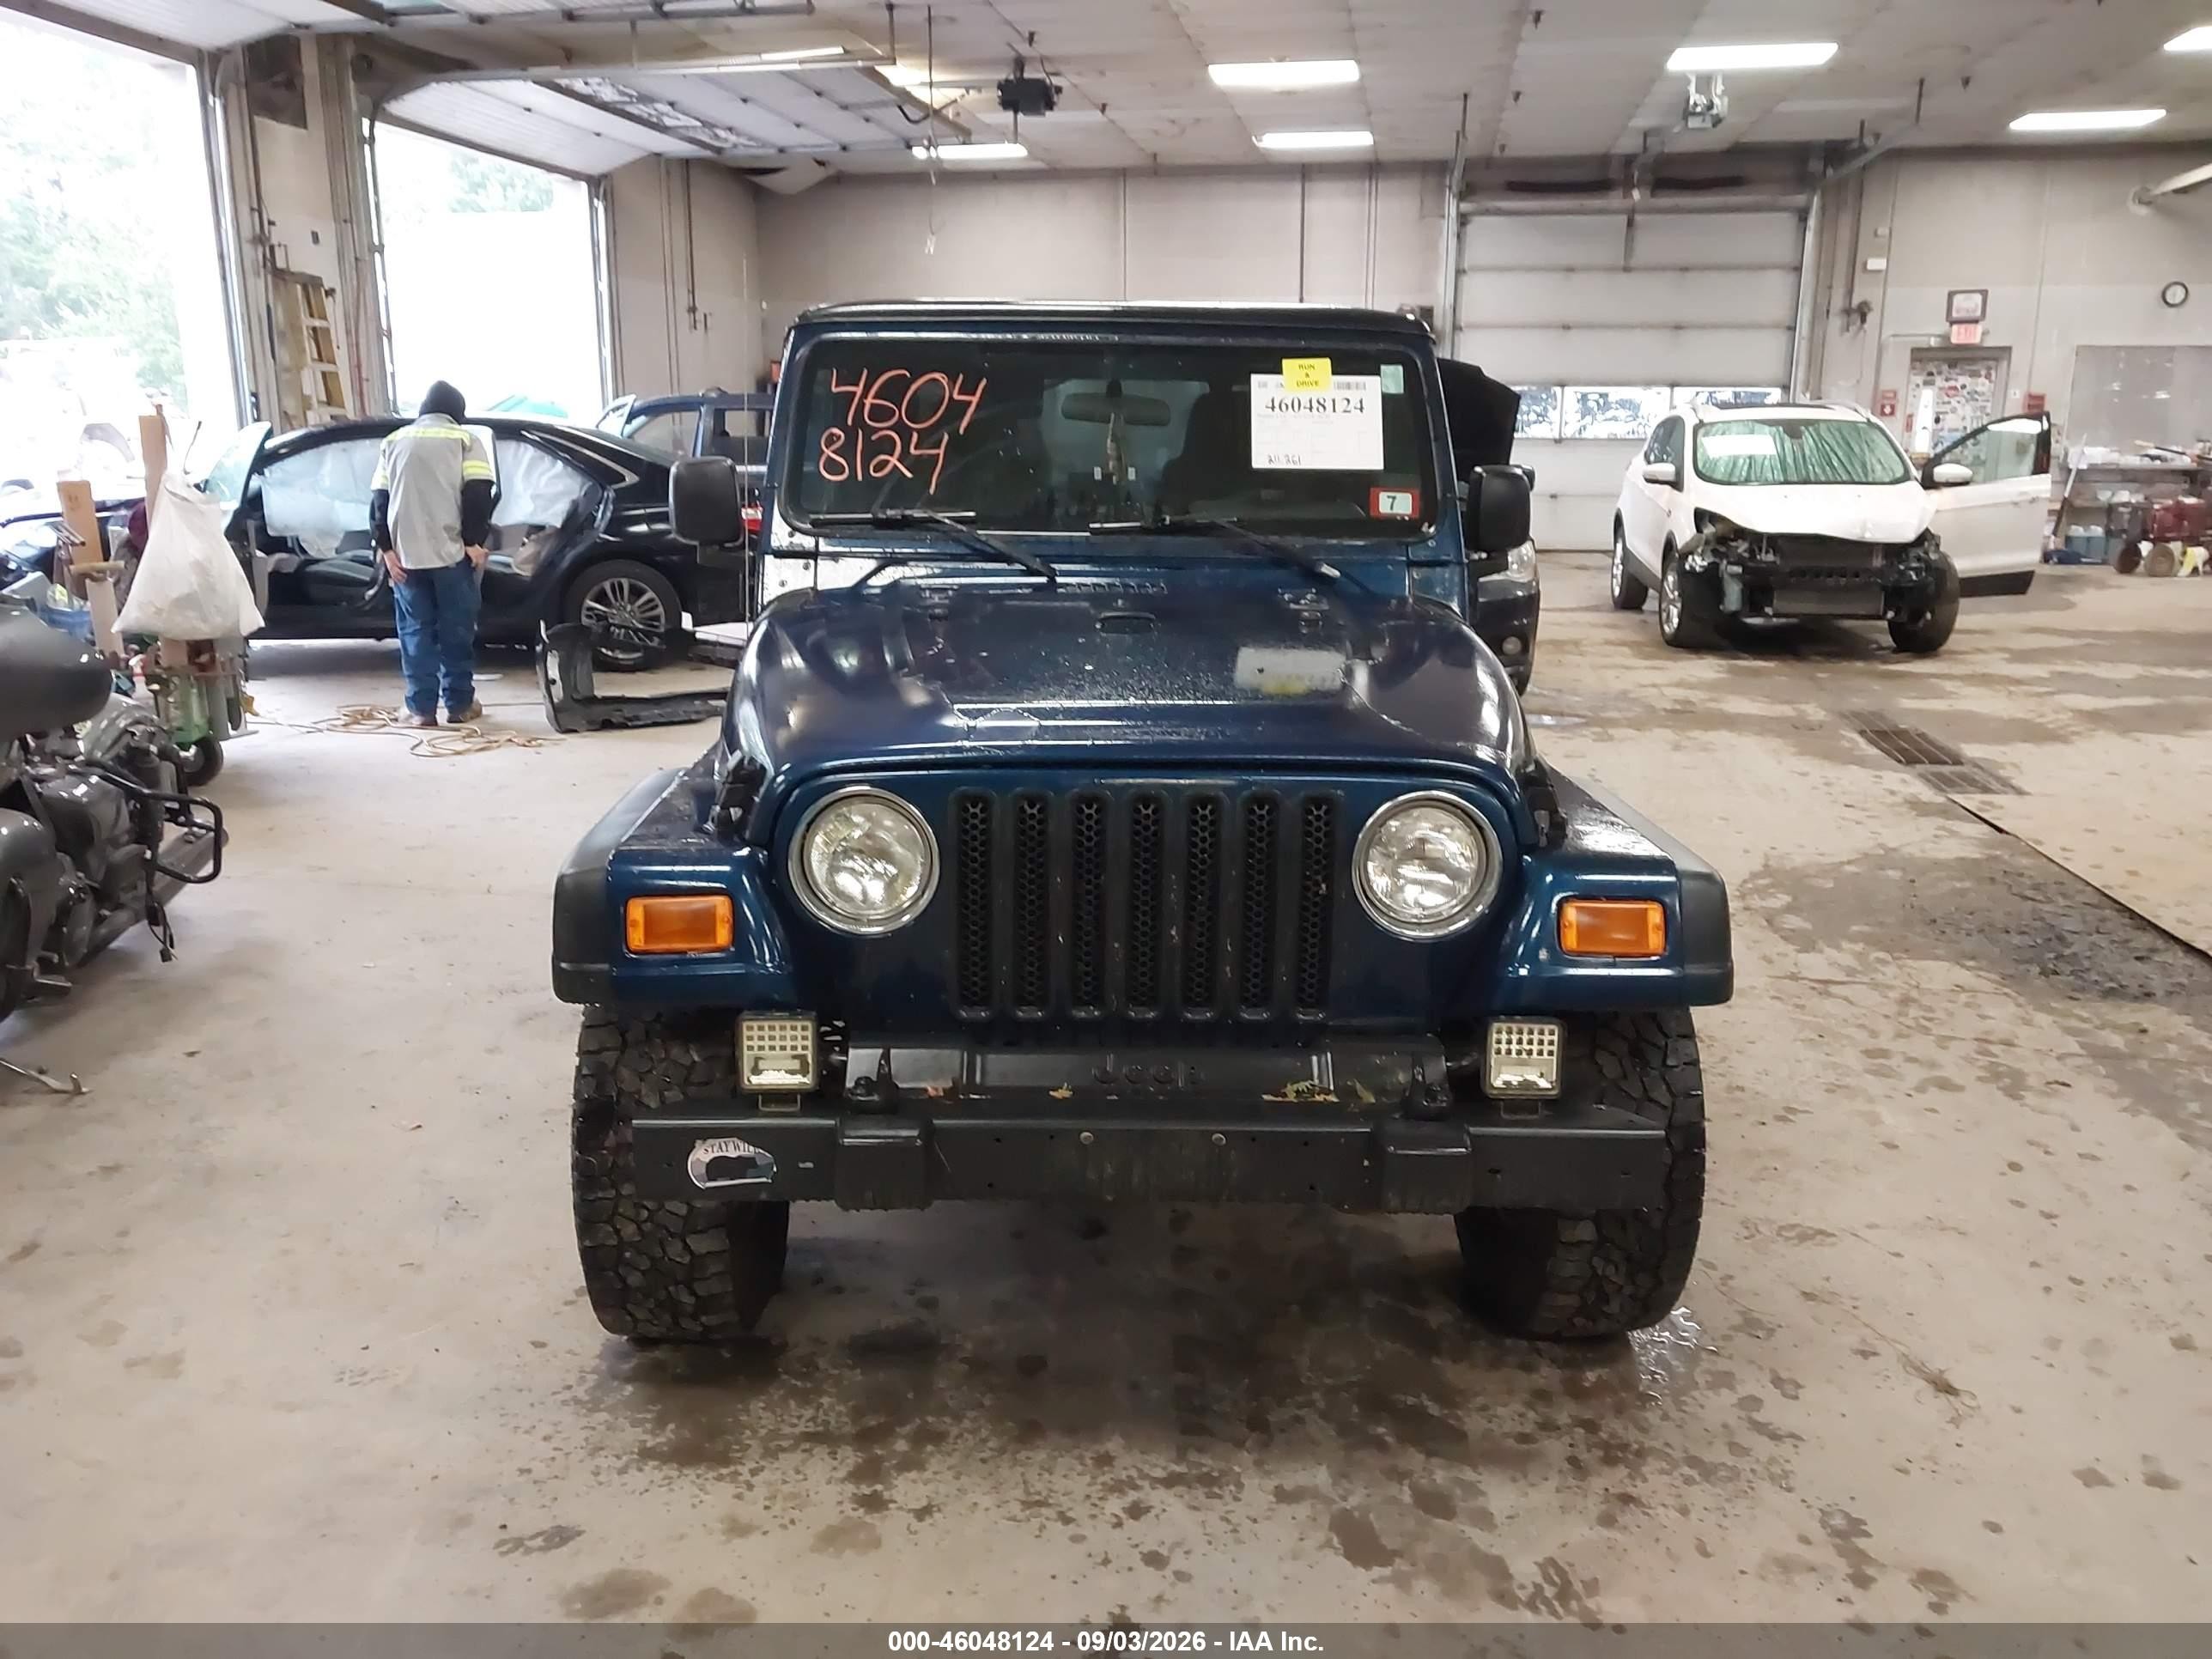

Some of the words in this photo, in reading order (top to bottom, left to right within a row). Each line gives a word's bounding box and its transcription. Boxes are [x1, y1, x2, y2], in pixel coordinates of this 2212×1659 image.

[1296, 380, 1320, 388] DRIVE
[830, 368, 988, 435] 4604
[1265, 397, 1364, 413] 46048124
[818, 428, 949, 495] 8124
[1386, 495, 1397, 511] 7
[702, 1140, 731, 1155] STAY
